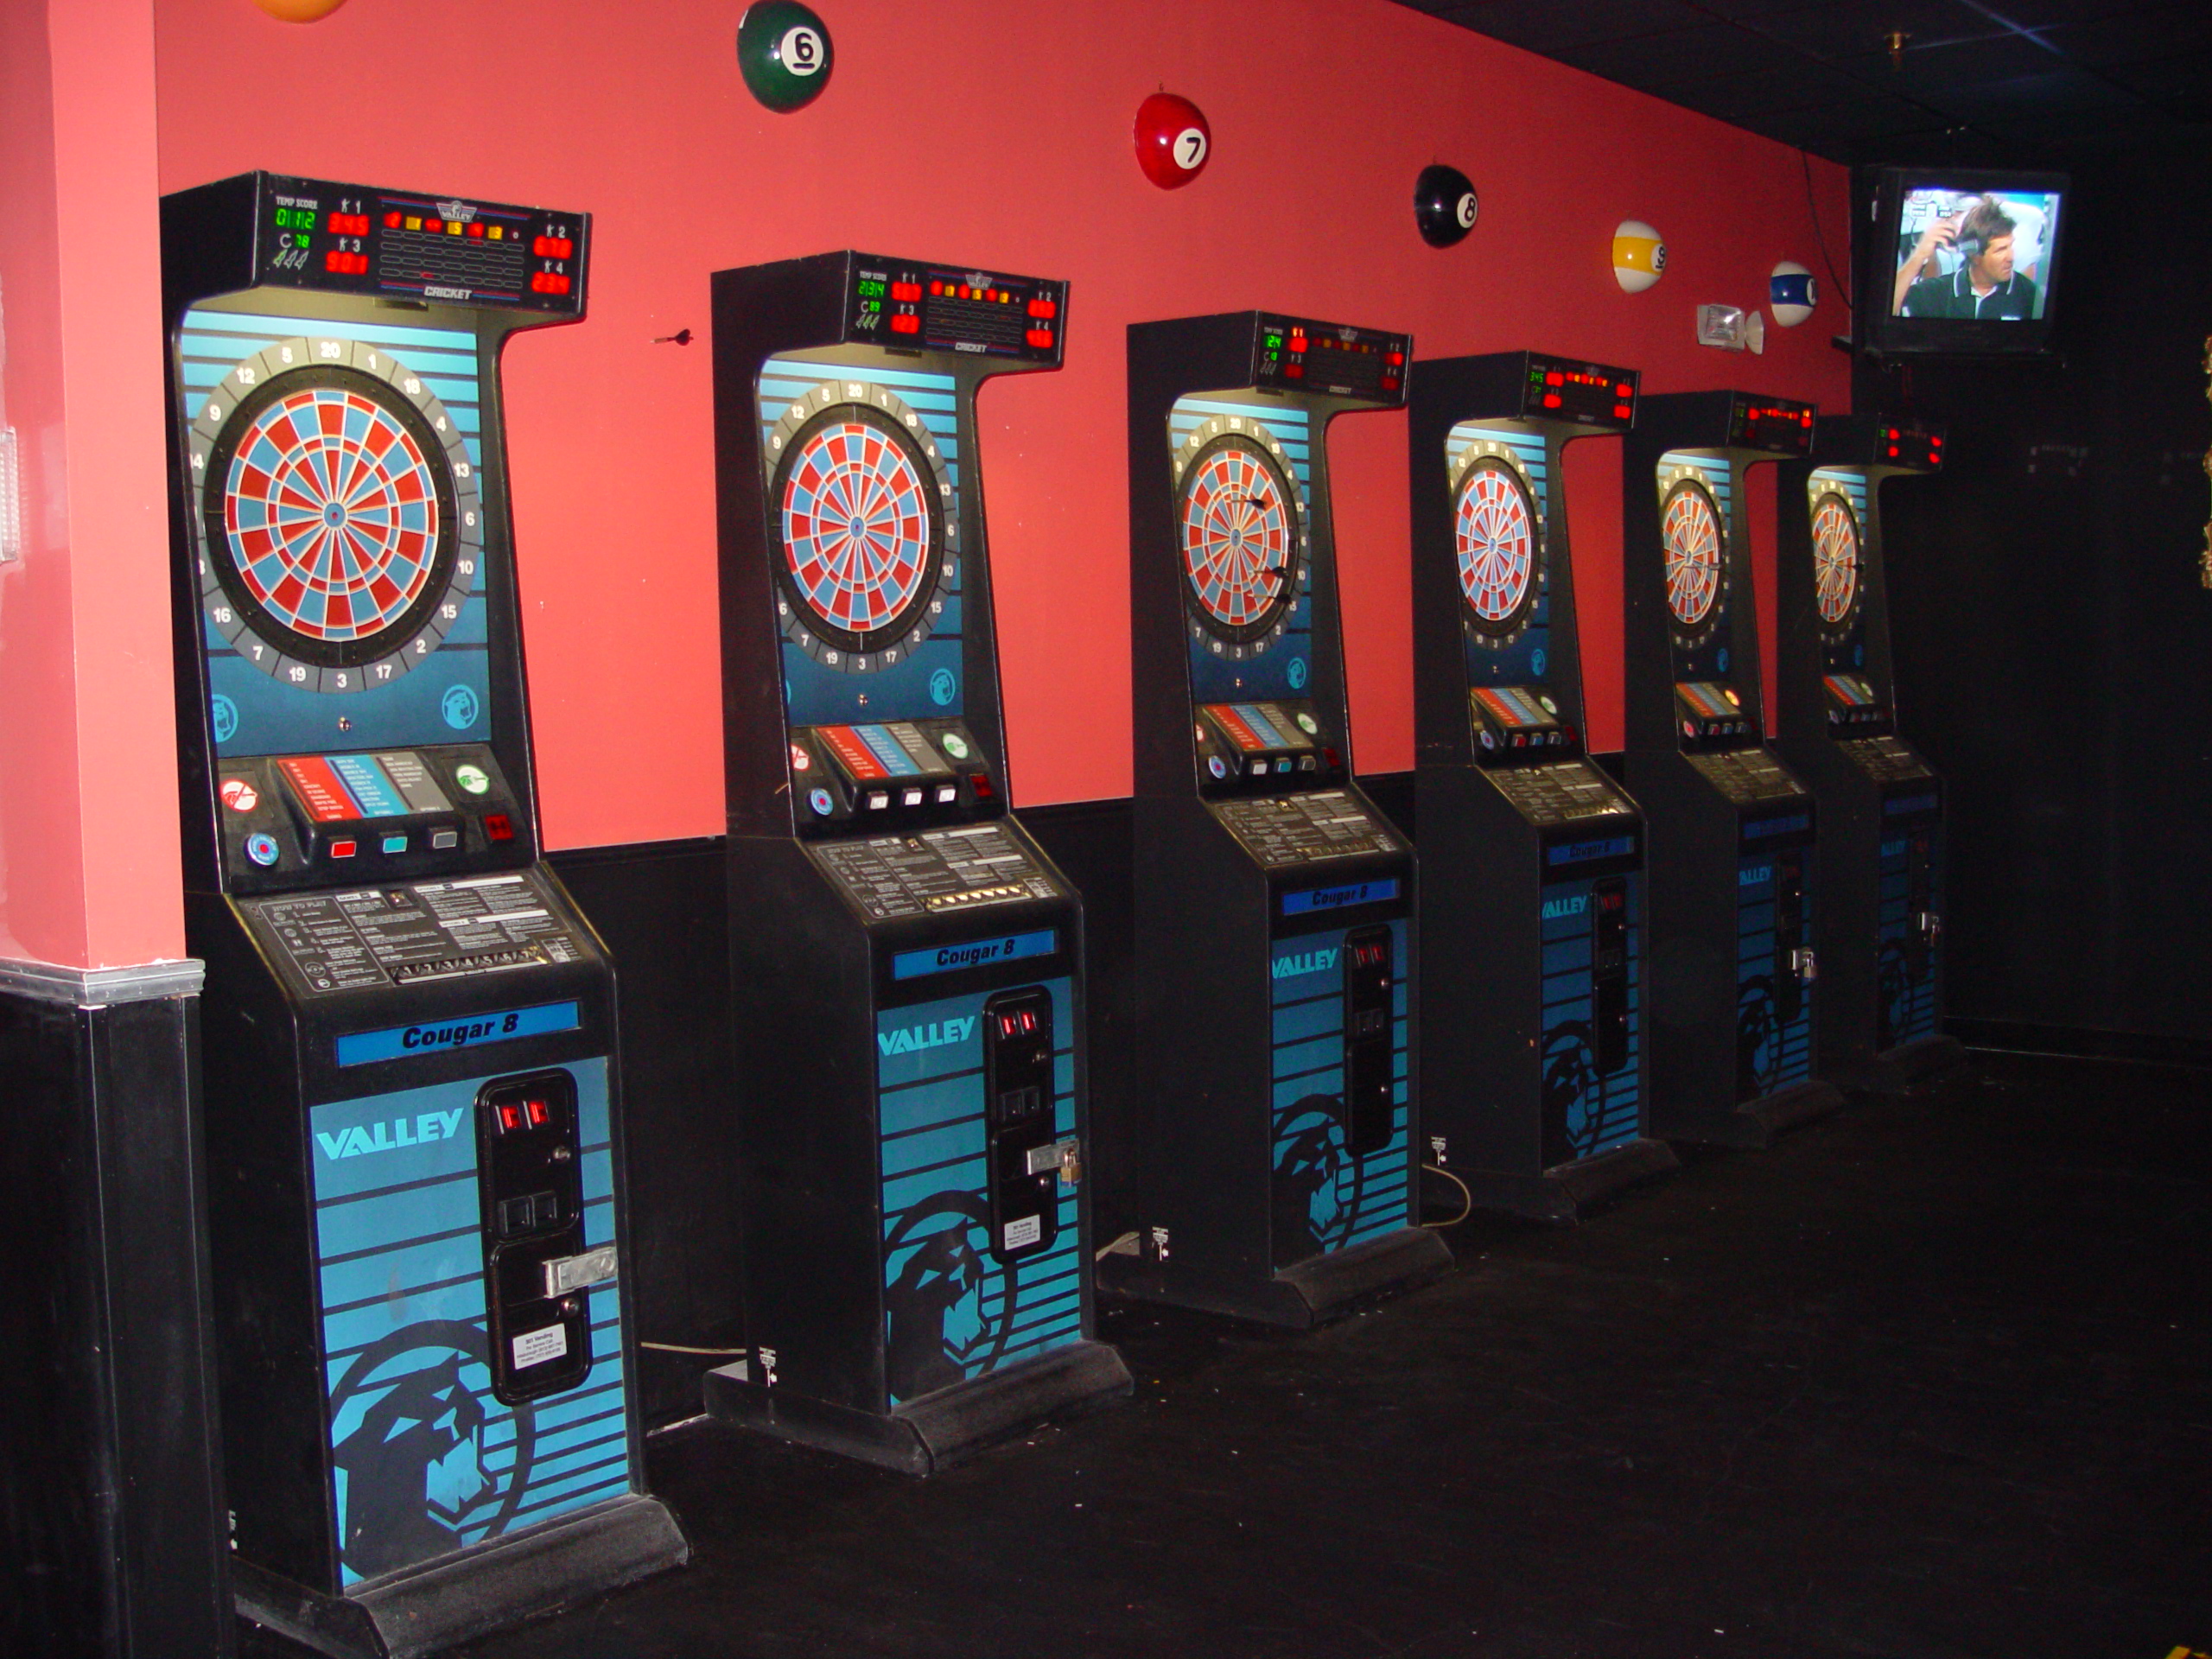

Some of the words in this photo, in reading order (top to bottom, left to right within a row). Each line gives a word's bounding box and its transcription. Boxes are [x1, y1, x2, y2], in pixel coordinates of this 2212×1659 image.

[794, 32, 814, 63] 6
[1185, 137, 1201, 163] 7
[276, 195, 295, 207] TEMP
[296, 198, 318, 210] SCORE
[1464, 197, 1476, 222] 8
[558, 226, 566, 238] 2
[353, 239, 360, 252] 3
[556, 262, 563, 274] 4
[424, 286, 473, 300] CRICKET
[321, 342, 341, 359] 20
[955, 341, 988, 353] CRICKET
[282, 347, 294, 364] 5
[368, 353, 377, 370] 1
[237, 367, 256, 385] 12
[403, 378, 421, 395] 18
[849, 384, 863, 397] 20
[822, 388, 830, 402] 5
[880, 394, 887, 407] 1
[209, 404, 221, 422] 9
[791, 405, 804, 420] 12
[435, 416, 448, 432] 4
[905, 413, 918, 427] 18
[1230, 417, 1241, 429] 20
[1211, 422, 1217, 433] 5
[772, 435, 782, 449] 9
[927, 444, 936, 458] 4
[454, 462, 470, 477] 13
[1287, 469, 1293, 480] 4
[939, 483, 951, 496] 13
[465, 512, 475, 526] 6
[947, 524, 955, 537] 6
[458, 560, 474, 575] 10
[942, 564, 954, 576] 10
[441, 605, 457, 620] 15
[931, 601, 942, 613] 15
[214, 607, 232, 623] 16
[912, 630, 921, 642] 2
[1195, 627, 1202, 638] 7
[1275, 625, 1281, 635] 2
[416, 639, 427, 654] 2
[801, 633, 810, 646] 7
[252, 645, 264, 661] 7
[825, 652, 838, 664] 19
[885, 651, 897, 664] 17
[1236, 648, 1242, 658] 3
[376, 664, 392, 679] 17
[858, 658, 867, 671] 3
[289, 666, 307, 682] 19
[337, 673, 348, 689] 3
[1312, 889, 1357, 906] Cougar
[936, 944, 1000, 967] Cougar
[1003, 939, 1015, 955] 8
[1273, 947, 1338, 980] VALLEY
[402, 1020, 495, 1049] Cougar
[502, 1014, 519, 1033] 8
[878, 1015, 976, 1056] VALLEY
[316, 1108, 464, 1160] VALLEY
